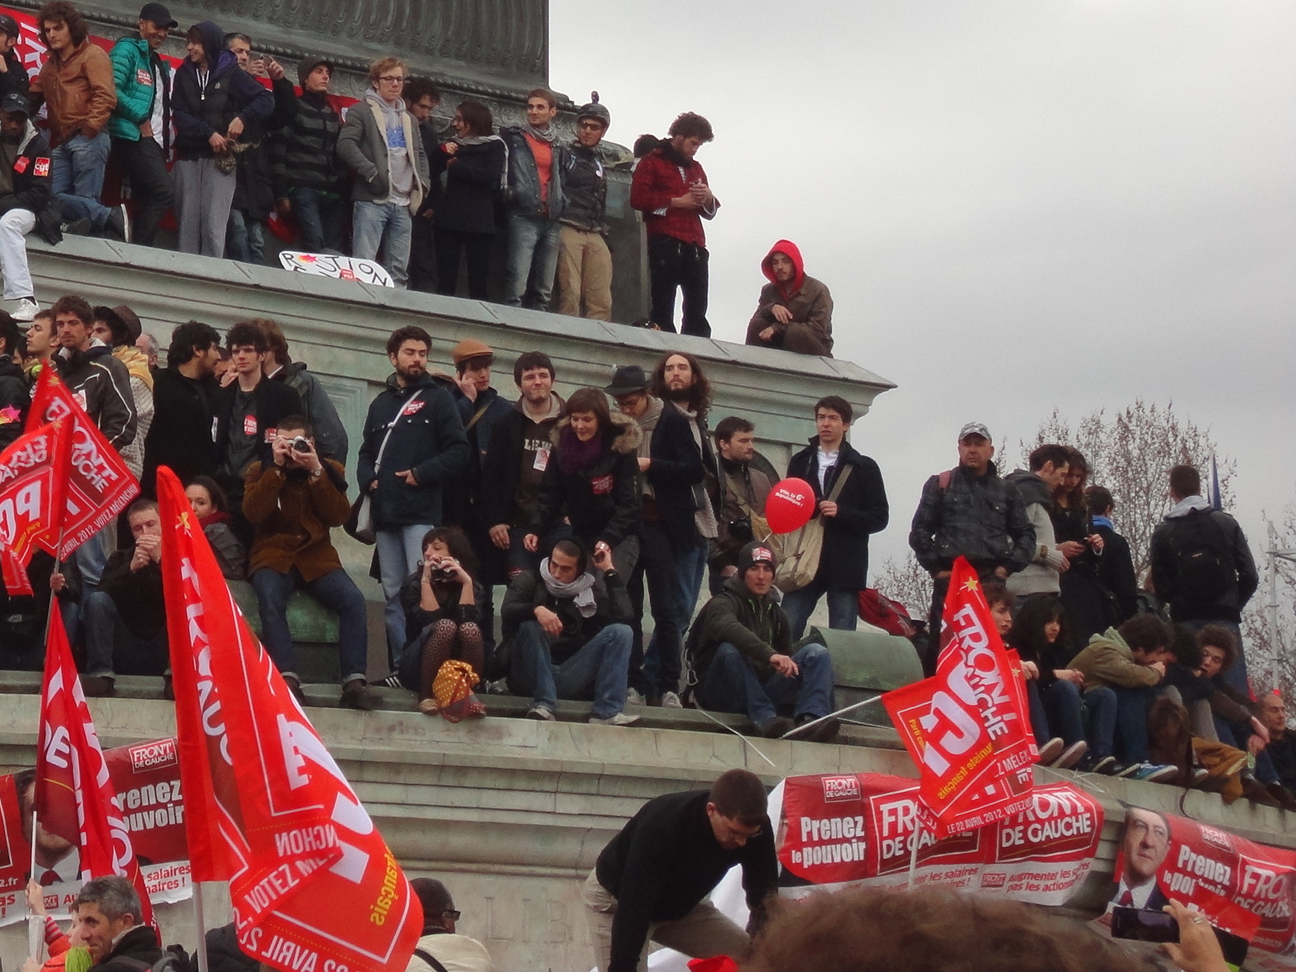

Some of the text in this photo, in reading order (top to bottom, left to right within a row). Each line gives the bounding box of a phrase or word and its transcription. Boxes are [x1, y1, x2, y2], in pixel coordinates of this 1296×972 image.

[133, 741, 174, 762] FRONT
[145, 752, 174, 767] GAUCHE
[116, 779, 183, 811] renez
[825, 778, 857, 791] FRONT
[800, 815, 864, 843] Prenez
[1002, 814, 1093, 848] DE GAUCHE
[791, 840, 866, 869] le pouvoir
[1177, 844, 1231, 886] Prenez
[146, 864, 191, 881] salaires
[244, 863, 300, 915] VOTEZ
